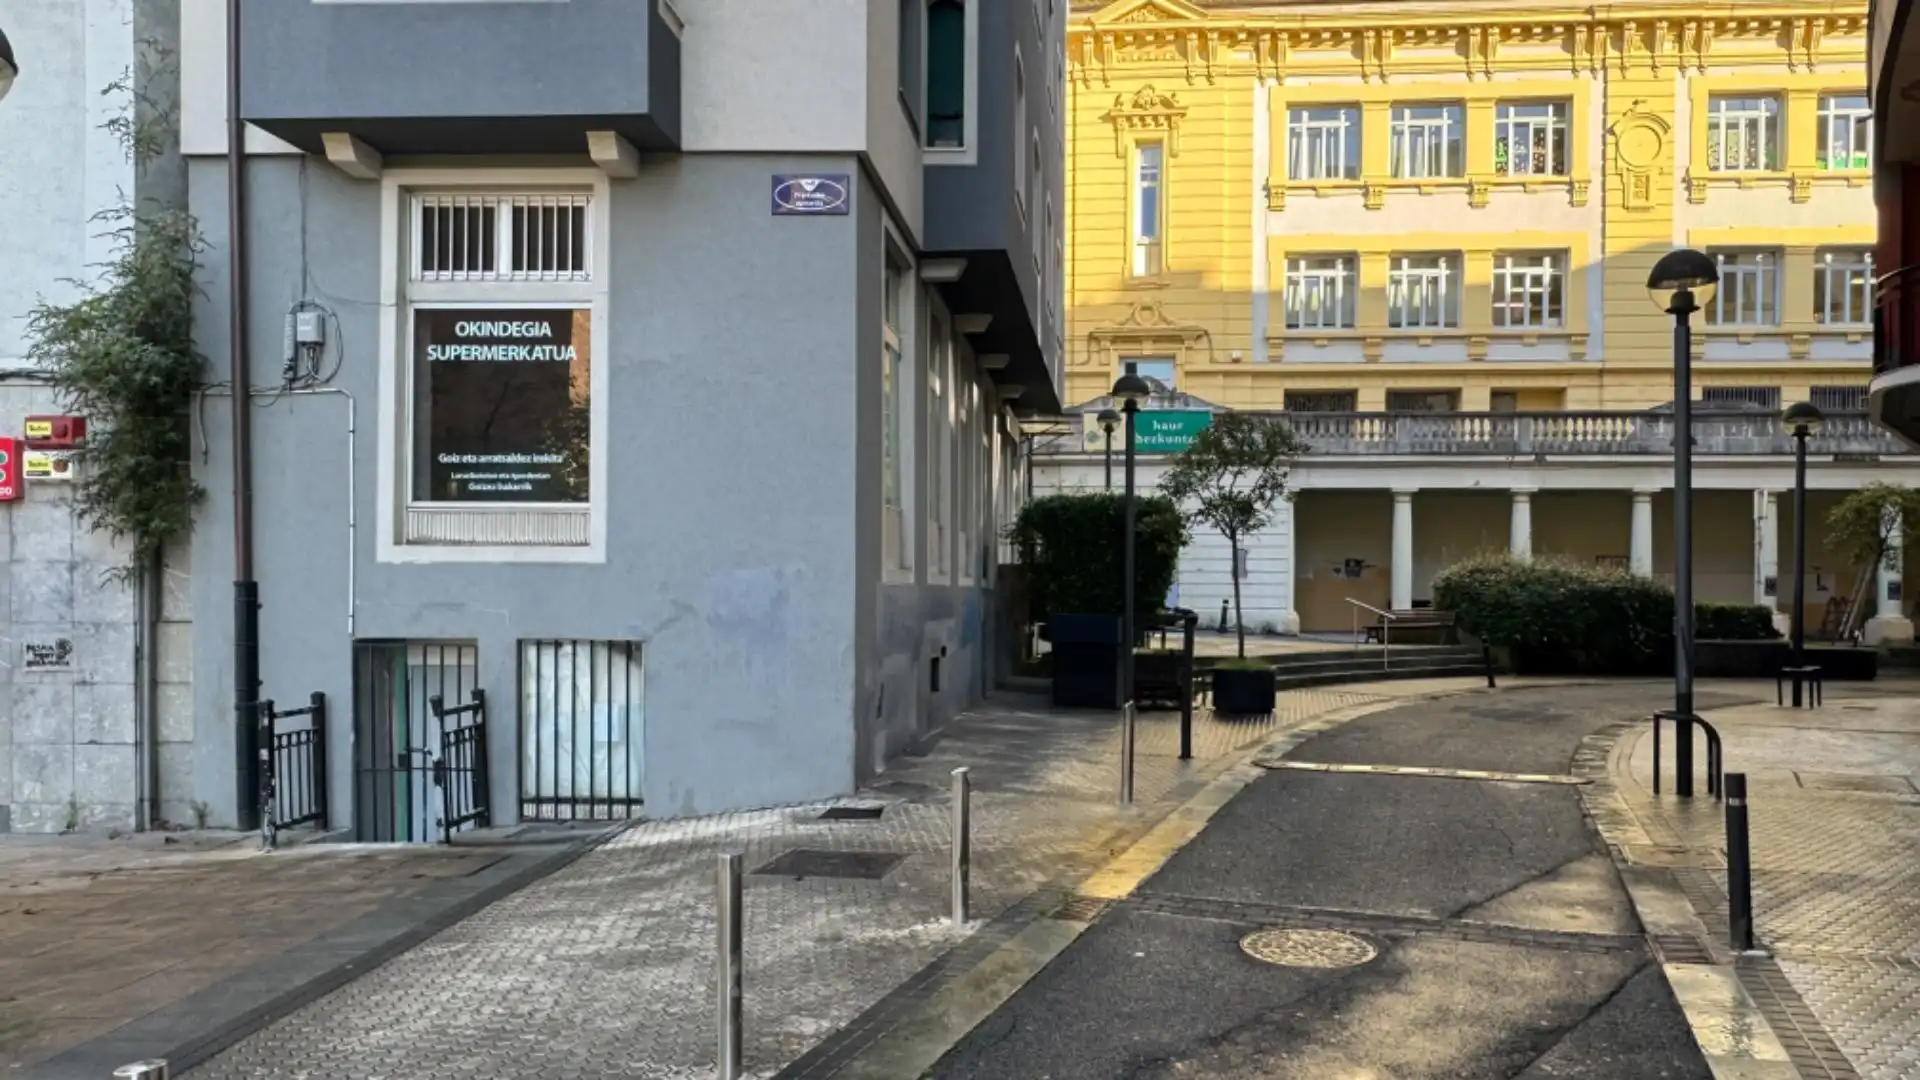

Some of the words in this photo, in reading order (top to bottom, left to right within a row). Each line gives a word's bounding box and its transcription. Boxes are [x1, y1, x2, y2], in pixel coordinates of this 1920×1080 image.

[455, 321, 552, 337] OKINDEGIA
[427, 344, 577, 361] SUPERMERKATUA
[1152, 420, 1183, 431] haur
